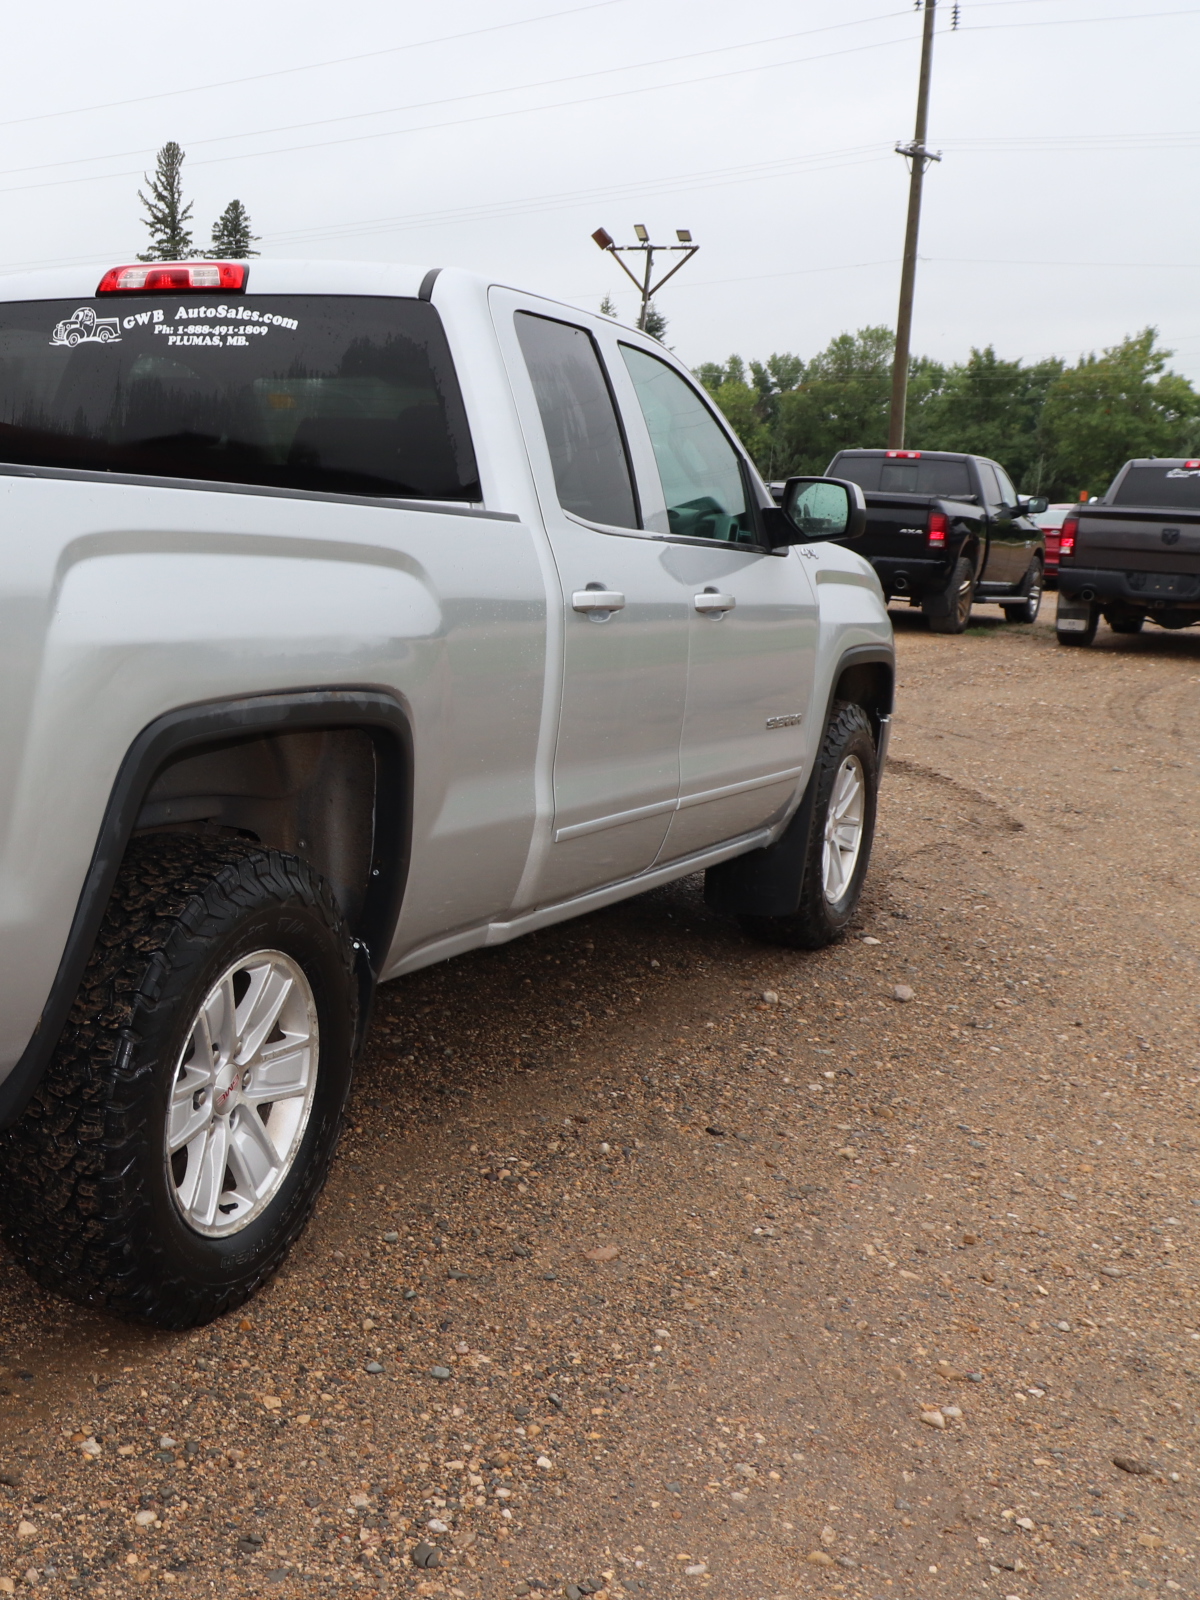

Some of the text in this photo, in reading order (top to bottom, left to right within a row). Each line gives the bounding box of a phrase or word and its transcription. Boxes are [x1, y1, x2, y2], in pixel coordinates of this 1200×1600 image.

[123, 305, 299, 330] GWB AutoSales.com
[154, 324, 268, 336] Ph: 1-888-491-1809
[168, 335, 249, 347] PLUMAS, MB.
[215, 1072, 240, 1107] GMC
